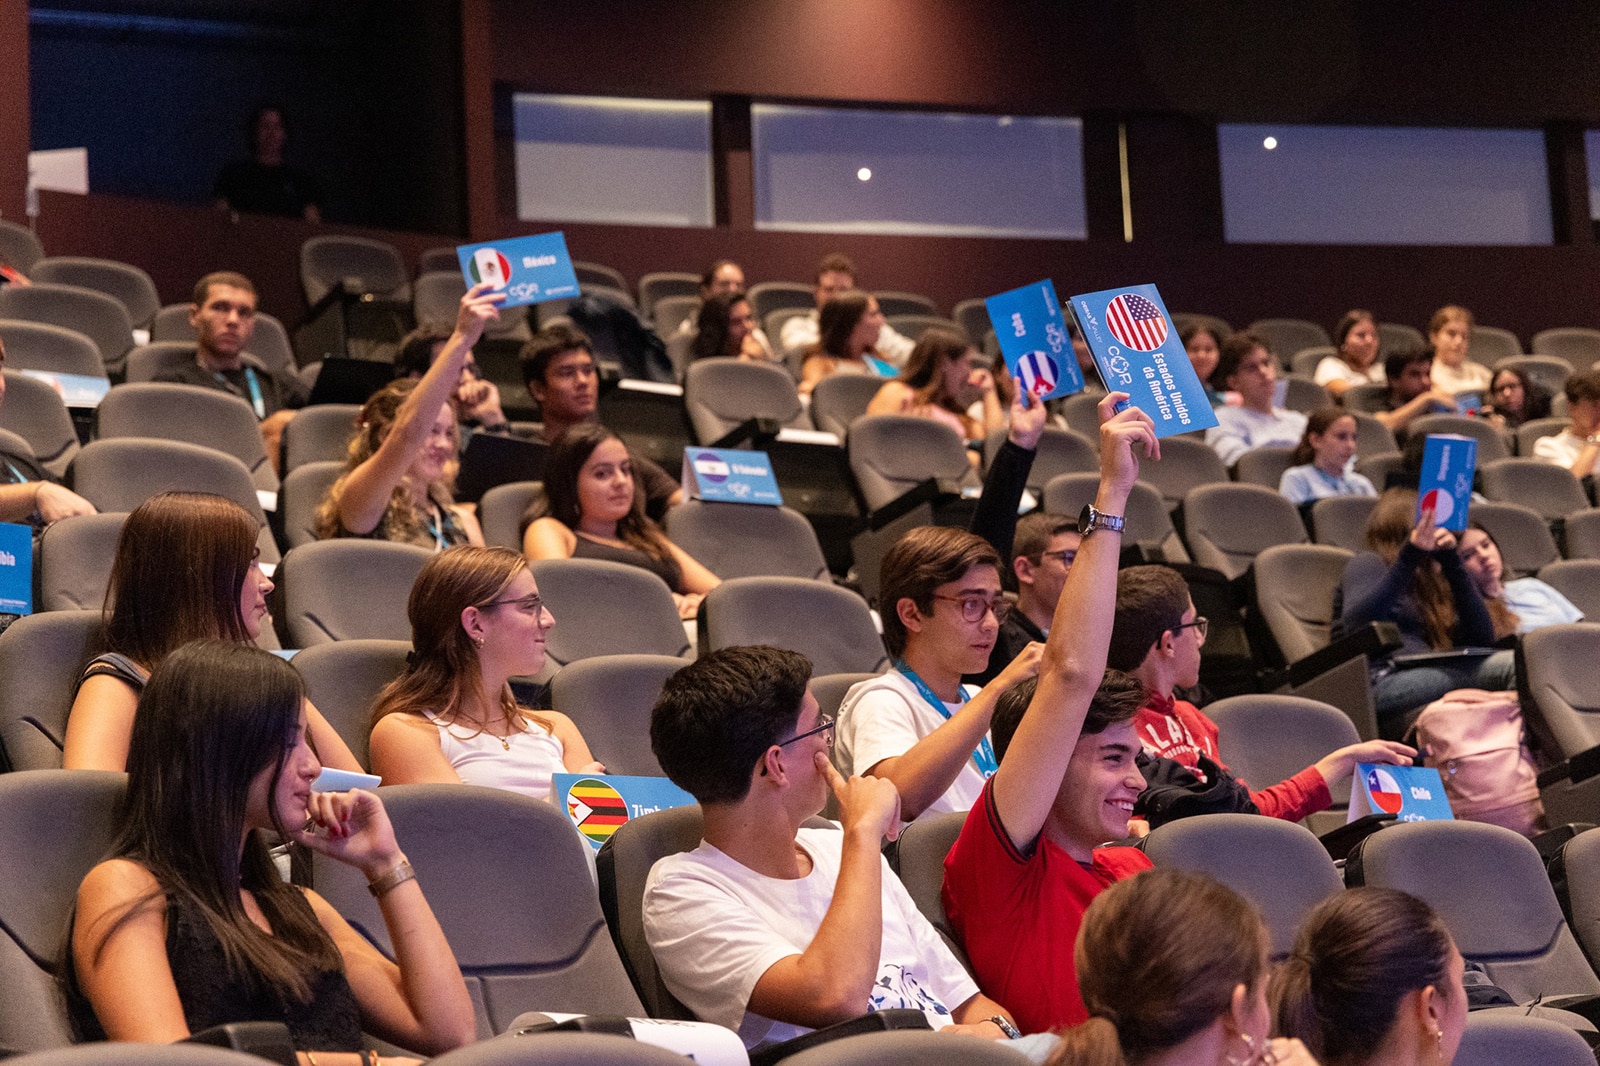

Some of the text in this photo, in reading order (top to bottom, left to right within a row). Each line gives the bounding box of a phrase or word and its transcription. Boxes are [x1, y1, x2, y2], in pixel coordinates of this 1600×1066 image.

[1142, 366, 1173, 421] da América
[1152, 352, 1191, 425] Estados Unidos
